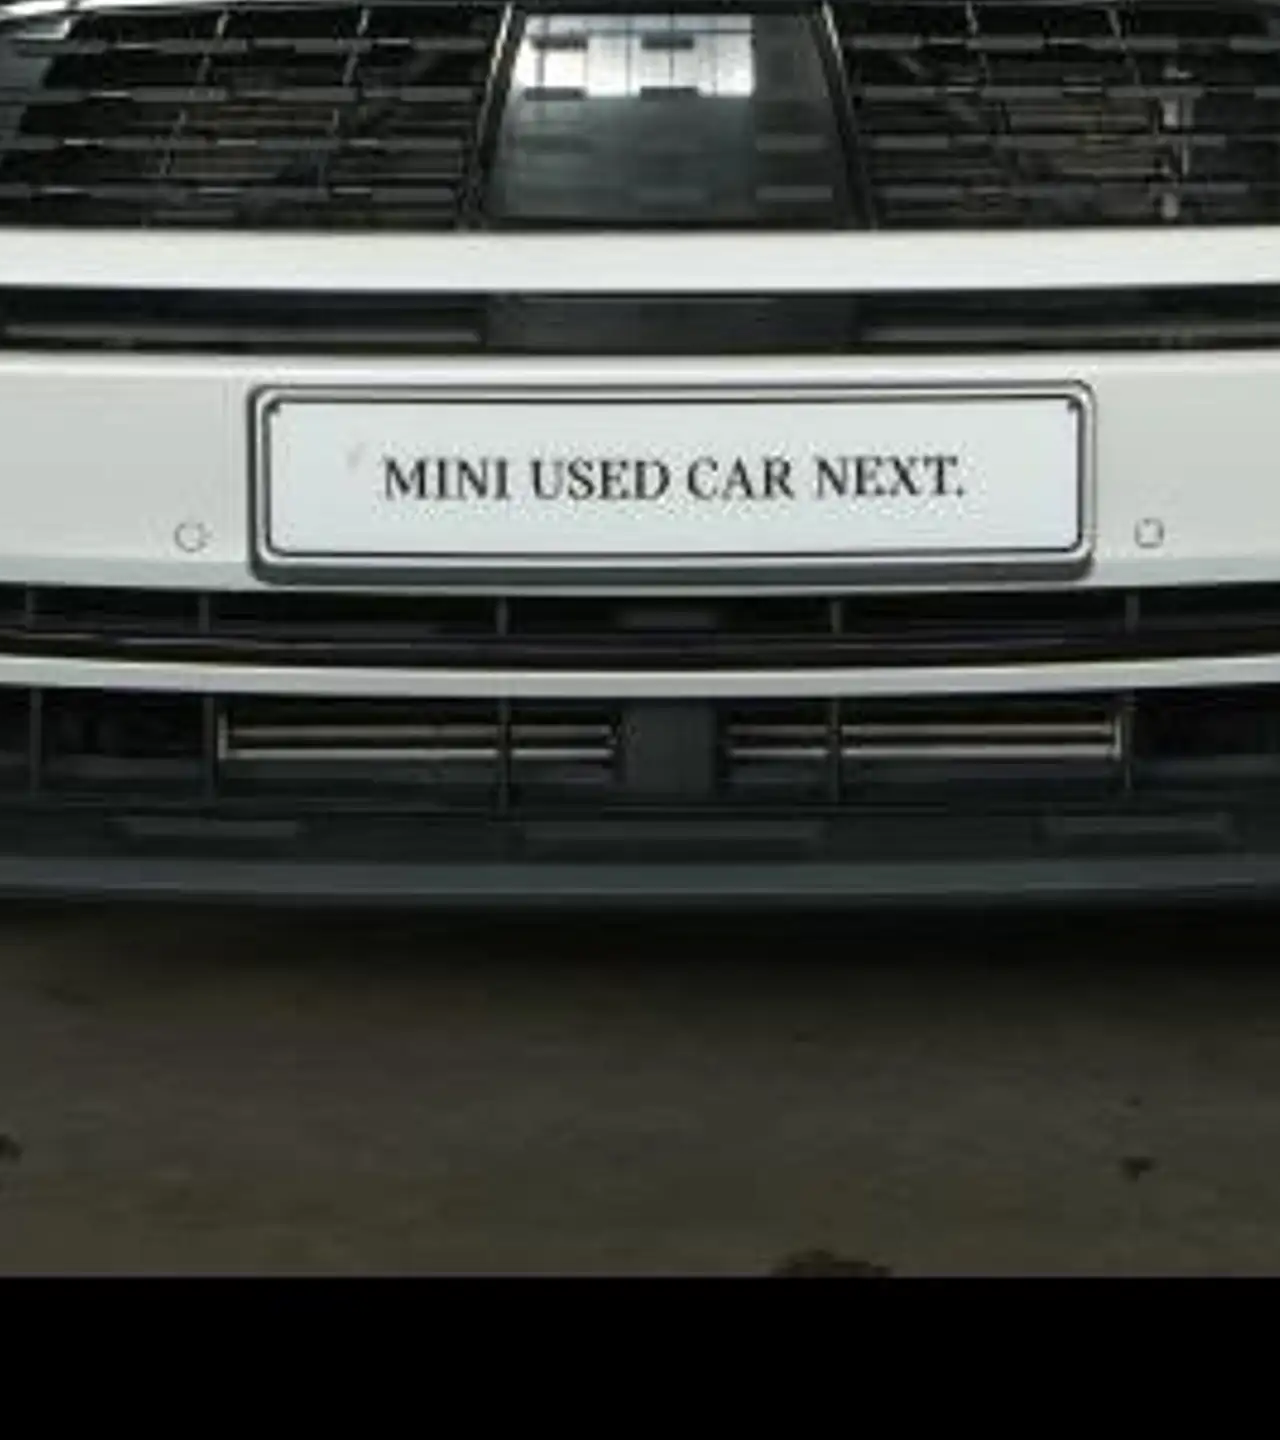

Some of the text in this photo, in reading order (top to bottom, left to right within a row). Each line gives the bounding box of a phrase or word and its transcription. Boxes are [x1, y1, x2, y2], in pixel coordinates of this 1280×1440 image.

[384, 453, 966, 502] MINI USED CAR NEXT.
